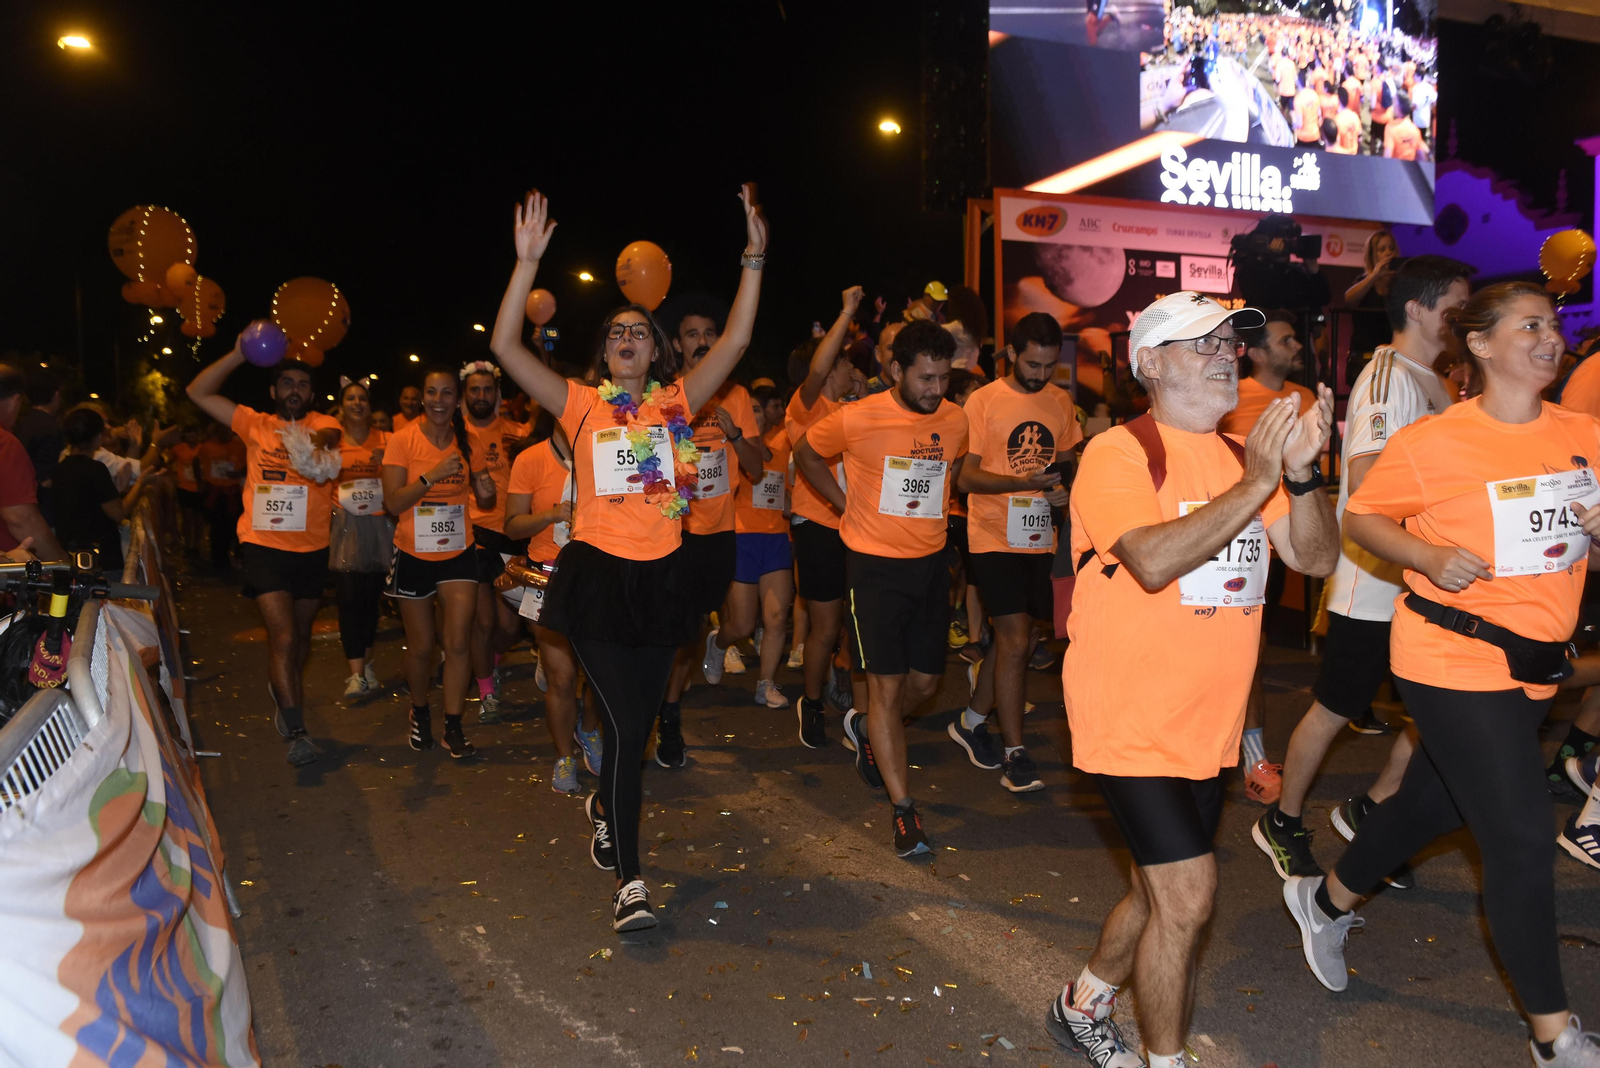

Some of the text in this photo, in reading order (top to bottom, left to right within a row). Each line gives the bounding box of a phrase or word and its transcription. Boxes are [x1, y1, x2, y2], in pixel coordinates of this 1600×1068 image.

[1079, 217, 1100, 229] ABC
[1112, 223, 1158, 237] Cruzcampo
[1166, 228, 1212, 238] TORRE SEVILLA
[911, 447, 944, 455] NOCTURNA
[1010, 462, 1019, 470] LA
[764, 483, 780, 494] 5667
[902, 478, 930, 493] 3965
[352, 490, 374, 501] 6326
[266, 500, 293, 512] 5574
[431, 520, 455, 533] 5852
[1022, 514, 1050, 527] 10157
[1207, 538, 1262, 563] 1735
